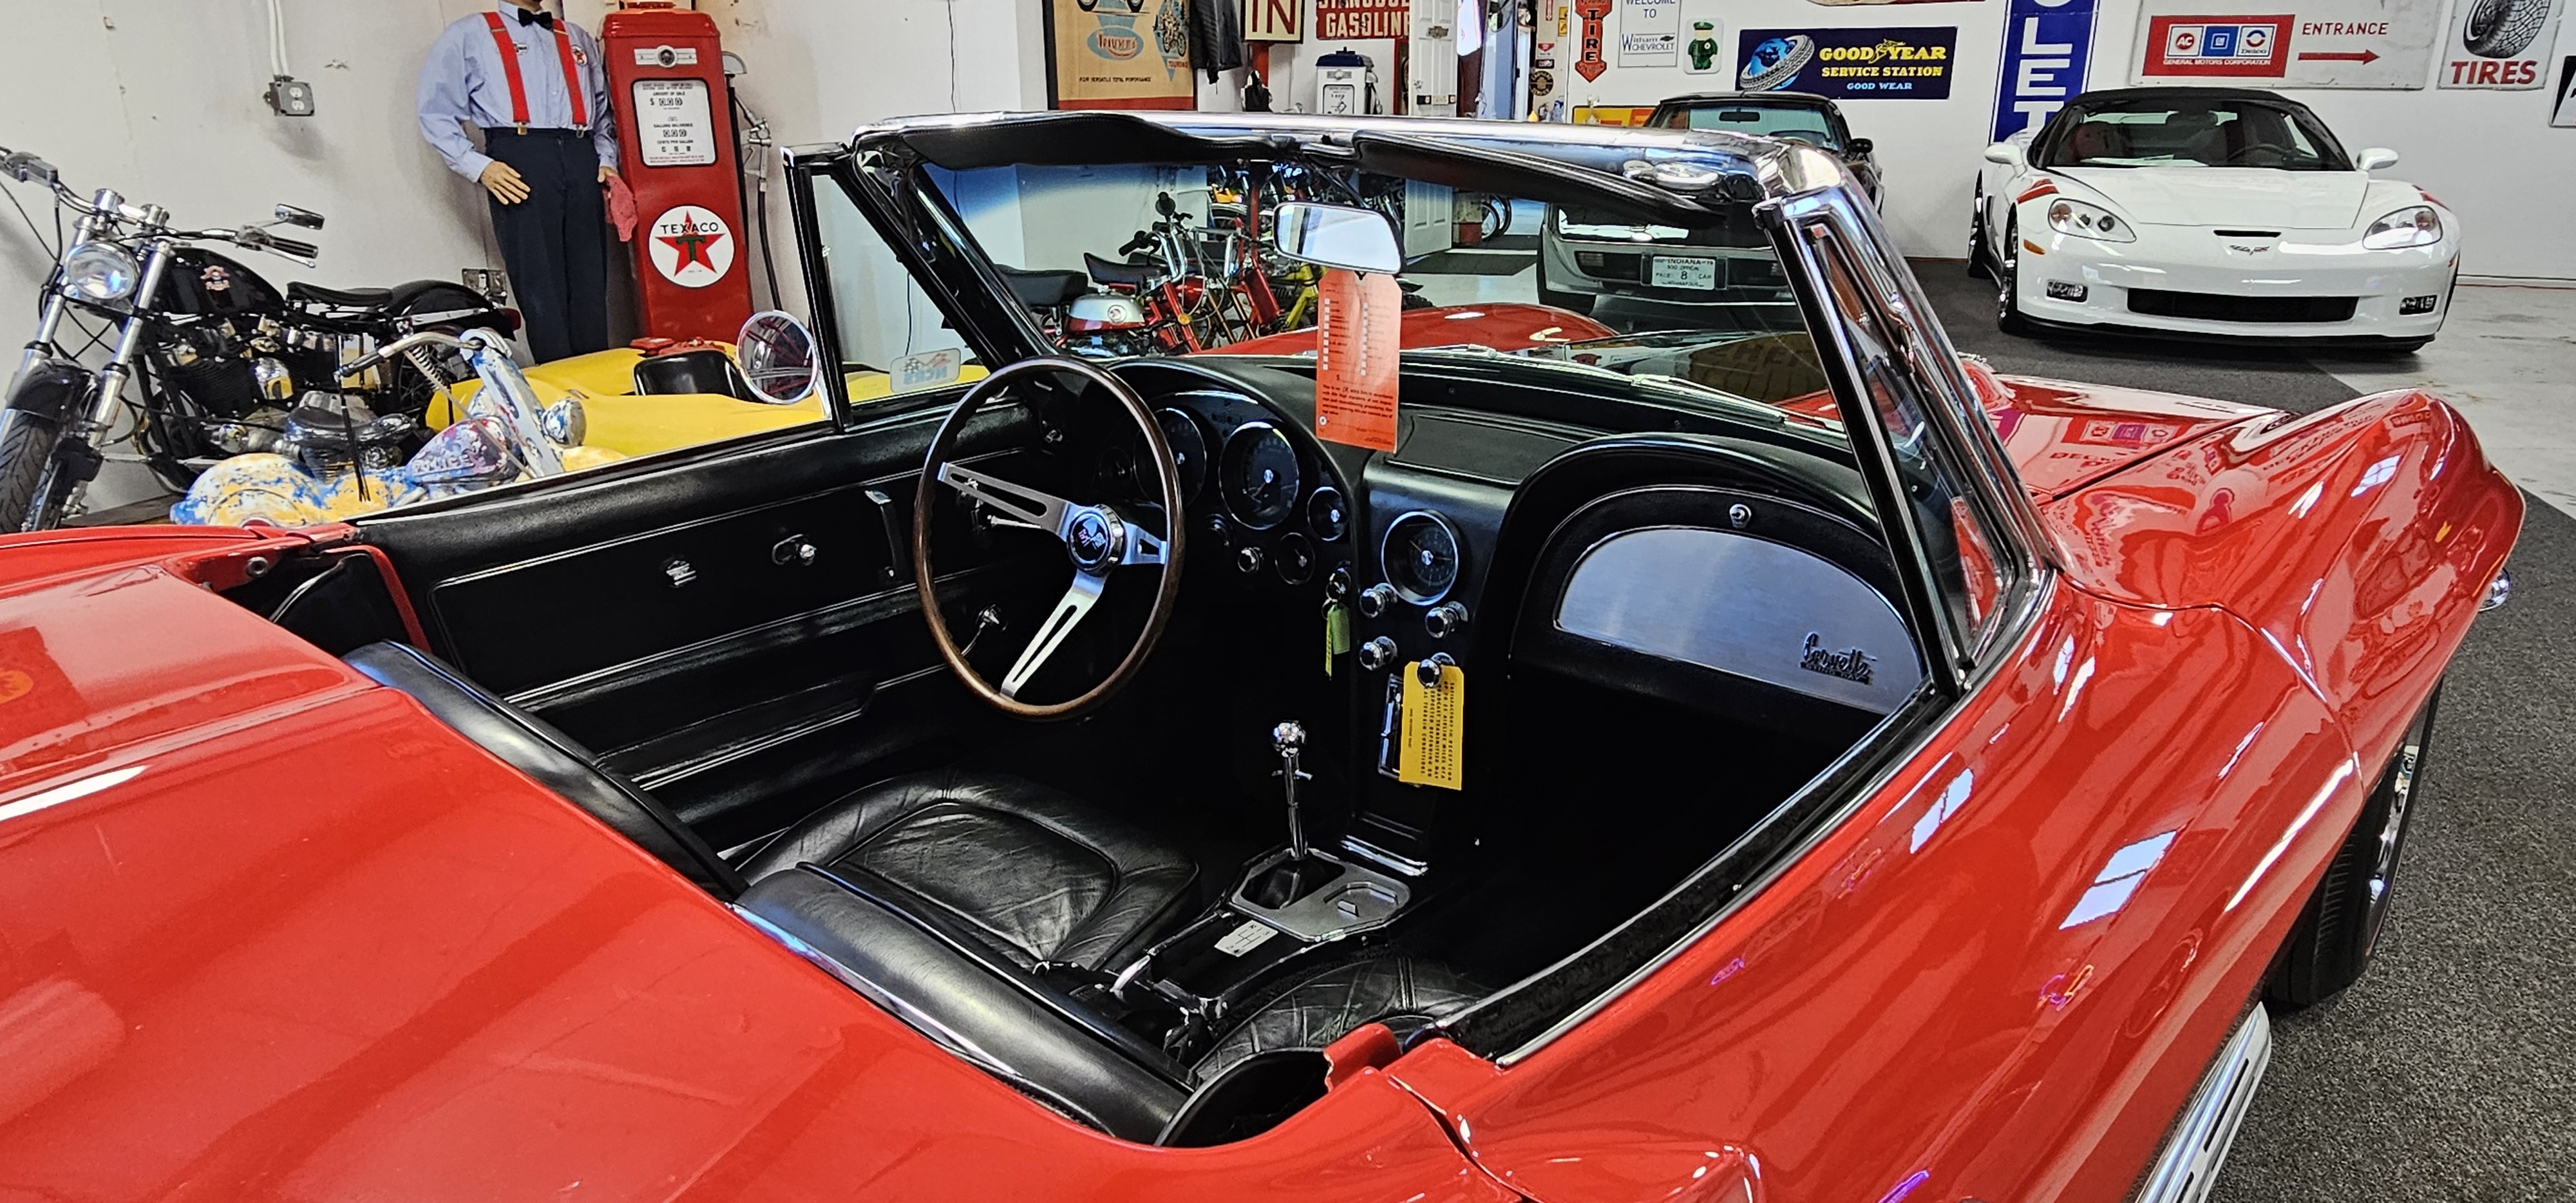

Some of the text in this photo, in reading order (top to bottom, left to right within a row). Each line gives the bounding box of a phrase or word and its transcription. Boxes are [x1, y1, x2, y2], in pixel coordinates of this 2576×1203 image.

[1252, 0, 1296, 35] IN
[1643, 8, 1657, 18] TO
[2302, 23, 2390, 35] ENTRANCE
[1586, 9, 1600, 61] TIRE
[2177, 36, 2194, 46] AC
[1632, 43, 1675, 51] CHEVROLET
[1822, 66, 1944, 77] SERVICE STATION
[2450, 60, 2538, 85] TIRES
[660, 222, 719, 234] TEXACO
[1681, 270, 1688, 280] 8
